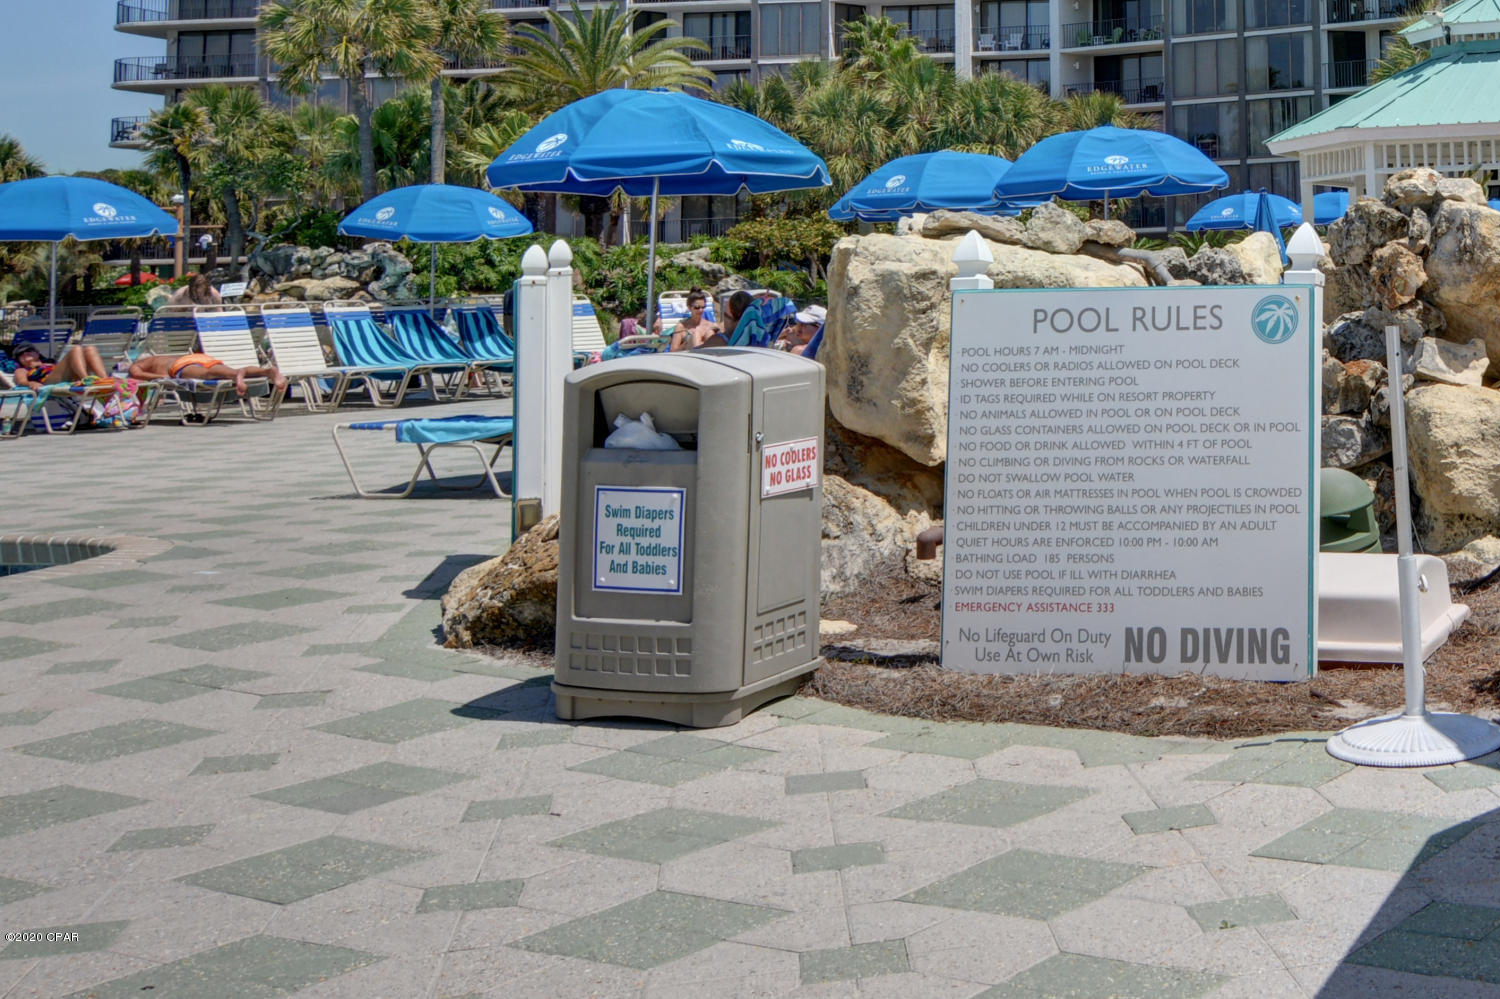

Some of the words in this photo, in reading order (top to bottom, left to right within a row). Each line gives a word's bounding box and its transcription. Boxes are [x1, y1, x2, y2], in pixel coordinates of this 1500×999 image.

[1088, 163, 1148, 172] EDGEWATER
[1033, 307, 1119, 334] POOL
[1132, 304, 1223, 331] RULES
[961, 347, 990, 357] POOL
[993, 346, 1031, 356] HOURS
[1034, 346, 1040, 355] 7
[1042, 346, 1059, 355] AM
[1068, 344, 1125, 355] MIDNIGHT
[960, 362, 979, 372] NO
[981, 362, 1031, 372] COOLERS
[1033, 361, 1050, 371] OR
[1052, 360, 1094, 371] RADIOS
[1096, 359, 1151, 370] ALLOWED
[1153, 359, 1172, 369] ON
[1175, 358, 1206, 369] POOL
[1209, 358, 1240, 368] DECK
[960, 378, 1006, 388] SHOWER
[1009, 377, 1048, 388] BEFORE
[1051, 376, 1105, 387] ENTERING
[1108, 376, 1139, 386] POOL
[960, 394, 971, 404] ID
[974, 393, 1000, 404] TAGS
[1003, 393, 1056, 404] REQUIRED
[1059, 392, 1094, 402] WHILE
[1096, 392, 1115, 402] ON
[1118, 391, 1159, 401] RESORT
[1162, 390, 1216, 401] PROPERTY
[959, 425, 977, 435] NO
[980, 425, 1012, 436] GLASS
[1014, 424, 1084, 435] CONTAINERS
[1086, 423, 1141, 434] ALLOWED
[1143, 423, 1162, 433] ON
[1165, 423, 1197, 433] POOL
[1199, 422, 1230, 432] DECK
[1233, 422, 1250, 432] OR
[1253, 423, 1266, 432] IN
[1269, 422, 1301, 432] POOL
[765, 455, 778, 469] NO
[780, 446, 816, 466] COOLERS
[958, 457, 976, 467] NO
[978, 456, 1030, 467] CLIMBING
[1033, 456, 1050, 466] OR
[1052, 456, 1091, 466] DIVING
[1094, 456, 1124, 466] FROM
[1127, 455, 1164, 466] ROCKS
[1167, 455, 1184, 465] OR
[1187, 455, 1250, 465] WATERFALL
[770, 472, 782, 486] NO
[785, 466, 811, 484] GLASS
[957, 473, 975, 483] DO
[978, 473, 1003, 483] NOT
[1005, 472, 1061, 483] SWALLOW
[1063, 472, 1094, 482] POOL
[1097, 472, 1135, 482] WATER
[957, 489, 974, 499] NO
[977, 488, 1014, 499] FLOATS
[1015, 488, 1031, 499] OR
[1034, 488, 1051, 498] AIR
[1053, 488, 1114, 498] MATTRESSES
[1116, 488, 1128, 498] IN
[1130, 488, 1161, 498] POOL
[1163, 488, 1198, 498] WHEN
[1200, 487, 1230, 498] POOL
[1233, 487, 1242, 498] IS
[1244, 487, 1302, 497] CROWDED
[605, 504, 631, 519] Swim
[635, 506, 674, 523] Diapers
[956, 505, 975, 515] NO
[977, 505, 1021, 515] HITTING
[1023, 504, 1040, 515] OR
[1043, 504, 1104, 514] THROWING
[1106, 504, 1138, 514] BALLS
[1140, 504, 1157, 514] OR
[1159, 504, 1183, 514] ANY
[1186, 504, 1252, 517] PROJECTILES
[1254, 504, 1266, 514] IN
[1269, 503, 1300, 514] POOL
[616, 523, 661, 540] Required
[956, 521, 1010, 531] CHILDREN
[1013, 520, 1051, 531] UNDER
[1056, 520, 1066, 531] 12
[1069, 520, 1099, 531] MUST
[1101, 520, 1114, 530] BE
[1116, 520, 1199, 530] ACCOMPANIED
[1202, 520, 1216, 530] BY
[1218, 520, 1237, 530] AN
[1239, 520, 1277, 530] ADULT
[600, 541, 615, 555] For
[618, 542, 631, 555] All
[635, 542, 678, 557] Toddlers
[955, 537, 988, 548] QUIET
[991, 537, 1029, 547] HOURS
[1031, 537, 1052, 547] ARE
[1055, 537, 1114, 547] ENFORCED
[1119, 537, 1144, 547] 10:00
[1146, 537, 1162, 547] PM
[1173, 536, 1198, 547] 10:00
[1201, 537, 1218, 547] AM
[955, 553, 1003, 563] BATHING
[1006, 553, 1037, 563] LOAD
[1044, 553, 1060, 563] 185
[1066, 553, 1114, 563] PERSONS
[609, 560, 628, 574] And
[632, 560, 667, 575] Babies
[955, 569, 973, 579] DO
[975, 569, 1000, 579] NOT
[1002, 569, 1022, 580] USE
[1024, 569, 1056, 580] POOL
[1058, 569, 1066, 579] IF
[1069, 569, 1084, 580] ILL
[1087, 569, 1118, 579] WITH
[1120, 569, 1176, 580] DIARRHEA
[954, 585, 983, 595] SWIM
[986, 585, 1029, 596] DIAPERS
[1031, 585, 1086, 597] REQUIRED
[1089, 586, 1111, 596] FOR
[1113, 586, 1133, 596] ALL
[1136, 586, 1194, 596] TODDLERS
[1197, 586, 1224, 597] AND
[1226, 586, 1263, 597] BABIES
[954, 602, 1022, 612] EMERGENCY
[1026, 602, 1092, 612] ASSISTANCE
[1096, 602, 1114, 612] 333
[959, 627, 980, 642] No
[985, 627, 1045, 647] Lifeguard
[1050, 628, 1072, 643] On
[1077, 628, 1111, 647] Duty
[1122, 626, 1167, 664] NO
[1180, 627, 1290, 664] DIVING
[975, 647, 1000, 662] Use
[1004, 648, 1022, 662] At
[1026, 647, 1060, 662] Own
[1065, 647, 1094, 663] Risk
